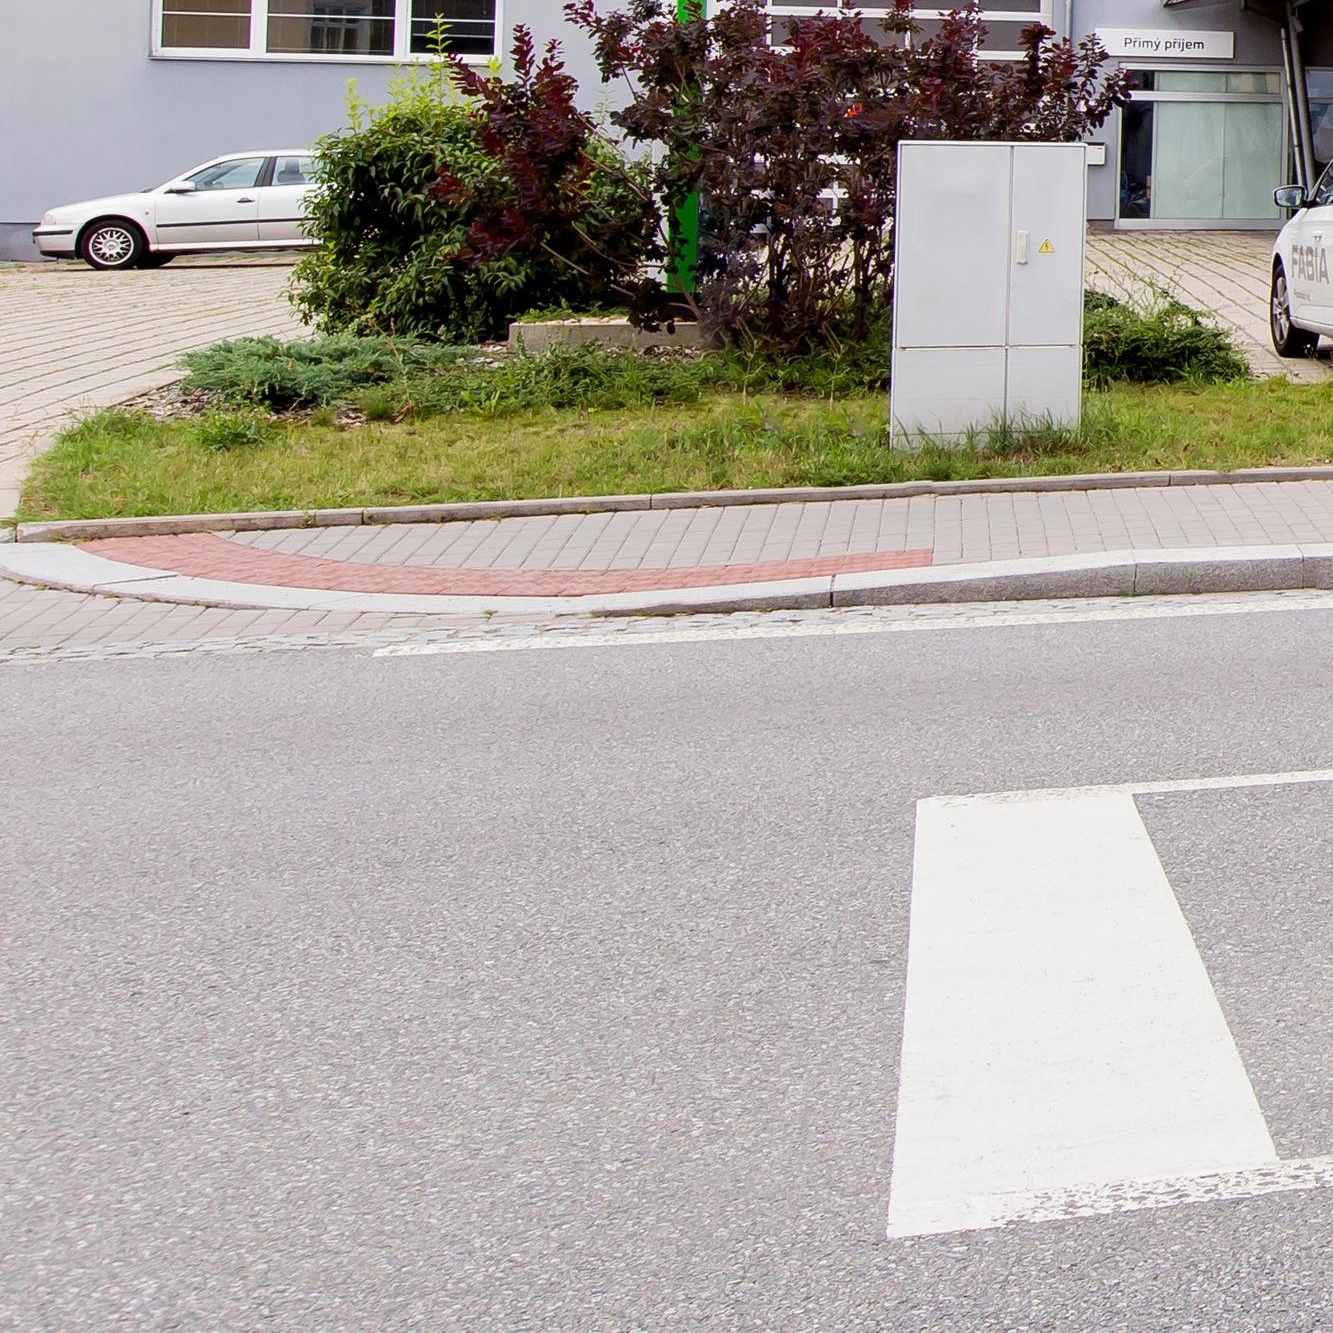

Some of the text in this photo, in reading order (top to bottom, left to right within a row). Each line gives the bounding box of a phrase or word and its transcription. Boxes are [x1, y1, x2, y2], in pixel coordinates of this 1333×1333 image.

[1123, 36, 1205, 53] Přímý příjem
[1291, 244, 1330, 284] FABIA
